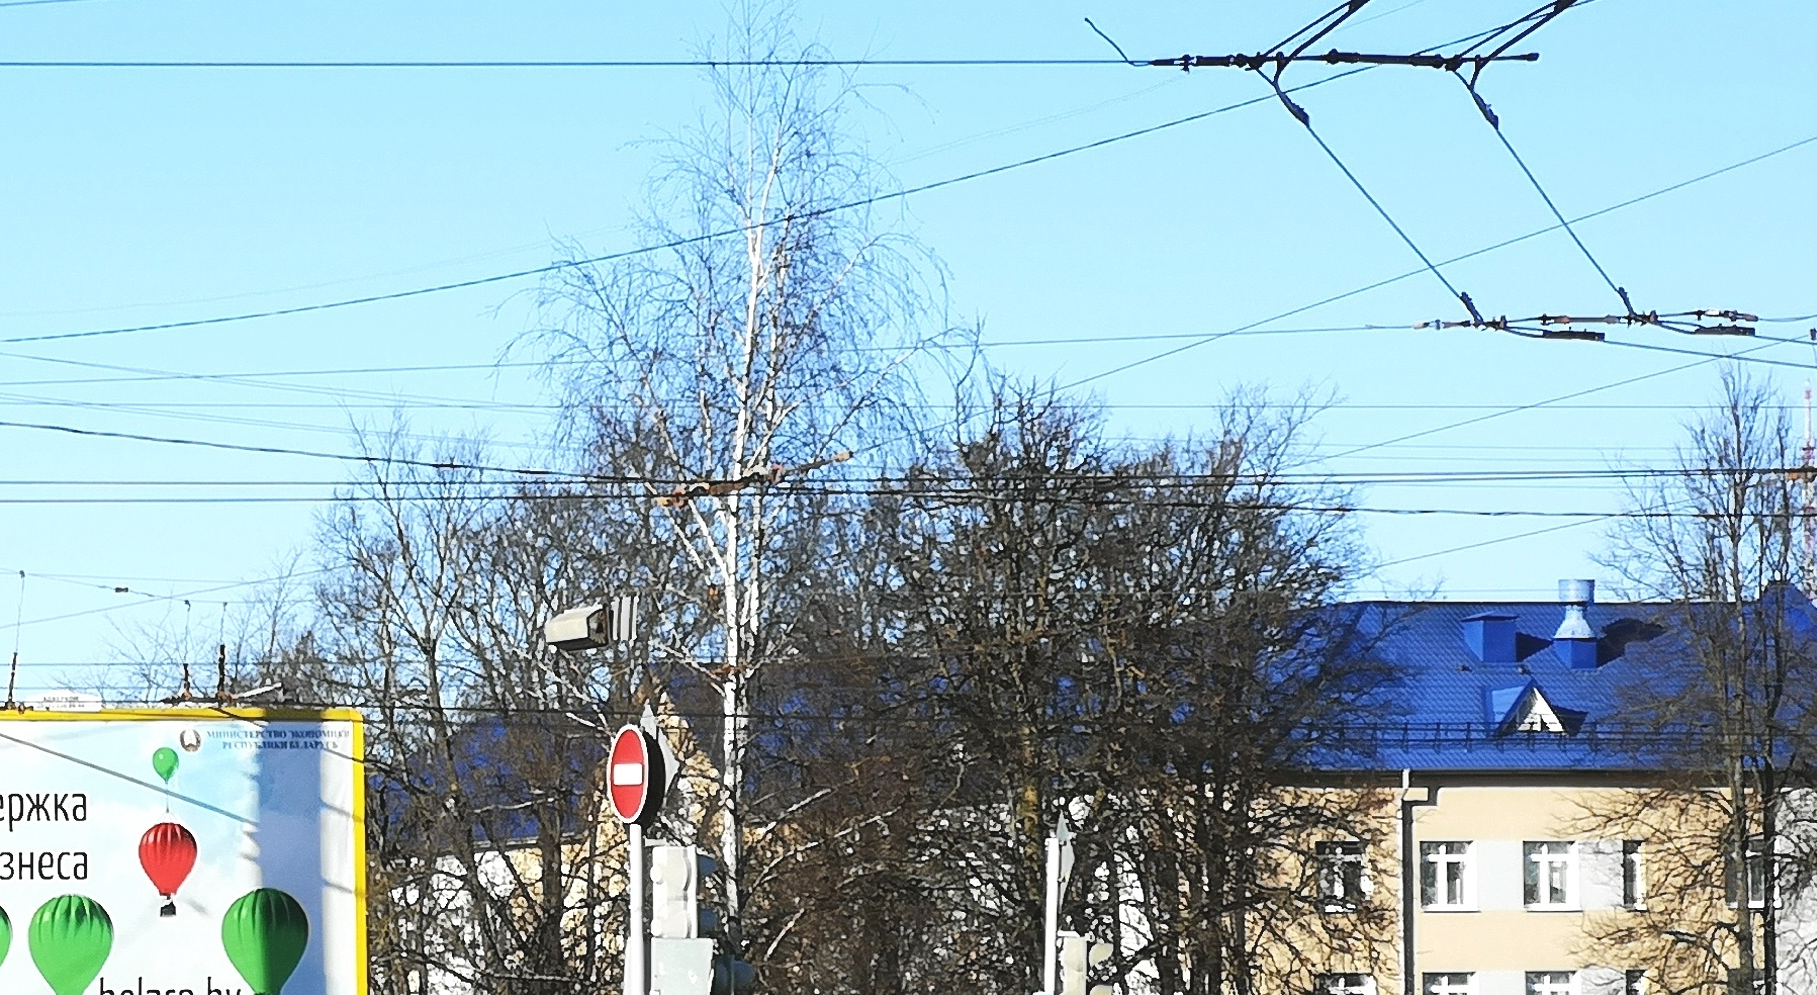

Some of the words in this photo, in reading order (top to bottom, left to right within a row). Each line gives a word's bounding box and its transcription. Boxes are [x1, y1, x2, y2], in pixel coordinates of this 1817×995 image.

[207, 730, 287, 740] МИНИСТЕРСТВО
[290, 730, 350, 739] ЭКОНОМИКИ
[222, 741, 288, 750] РЕСПУБЛИКИ
[289, 741, 339, 750] БЕЛАРУСЬ
